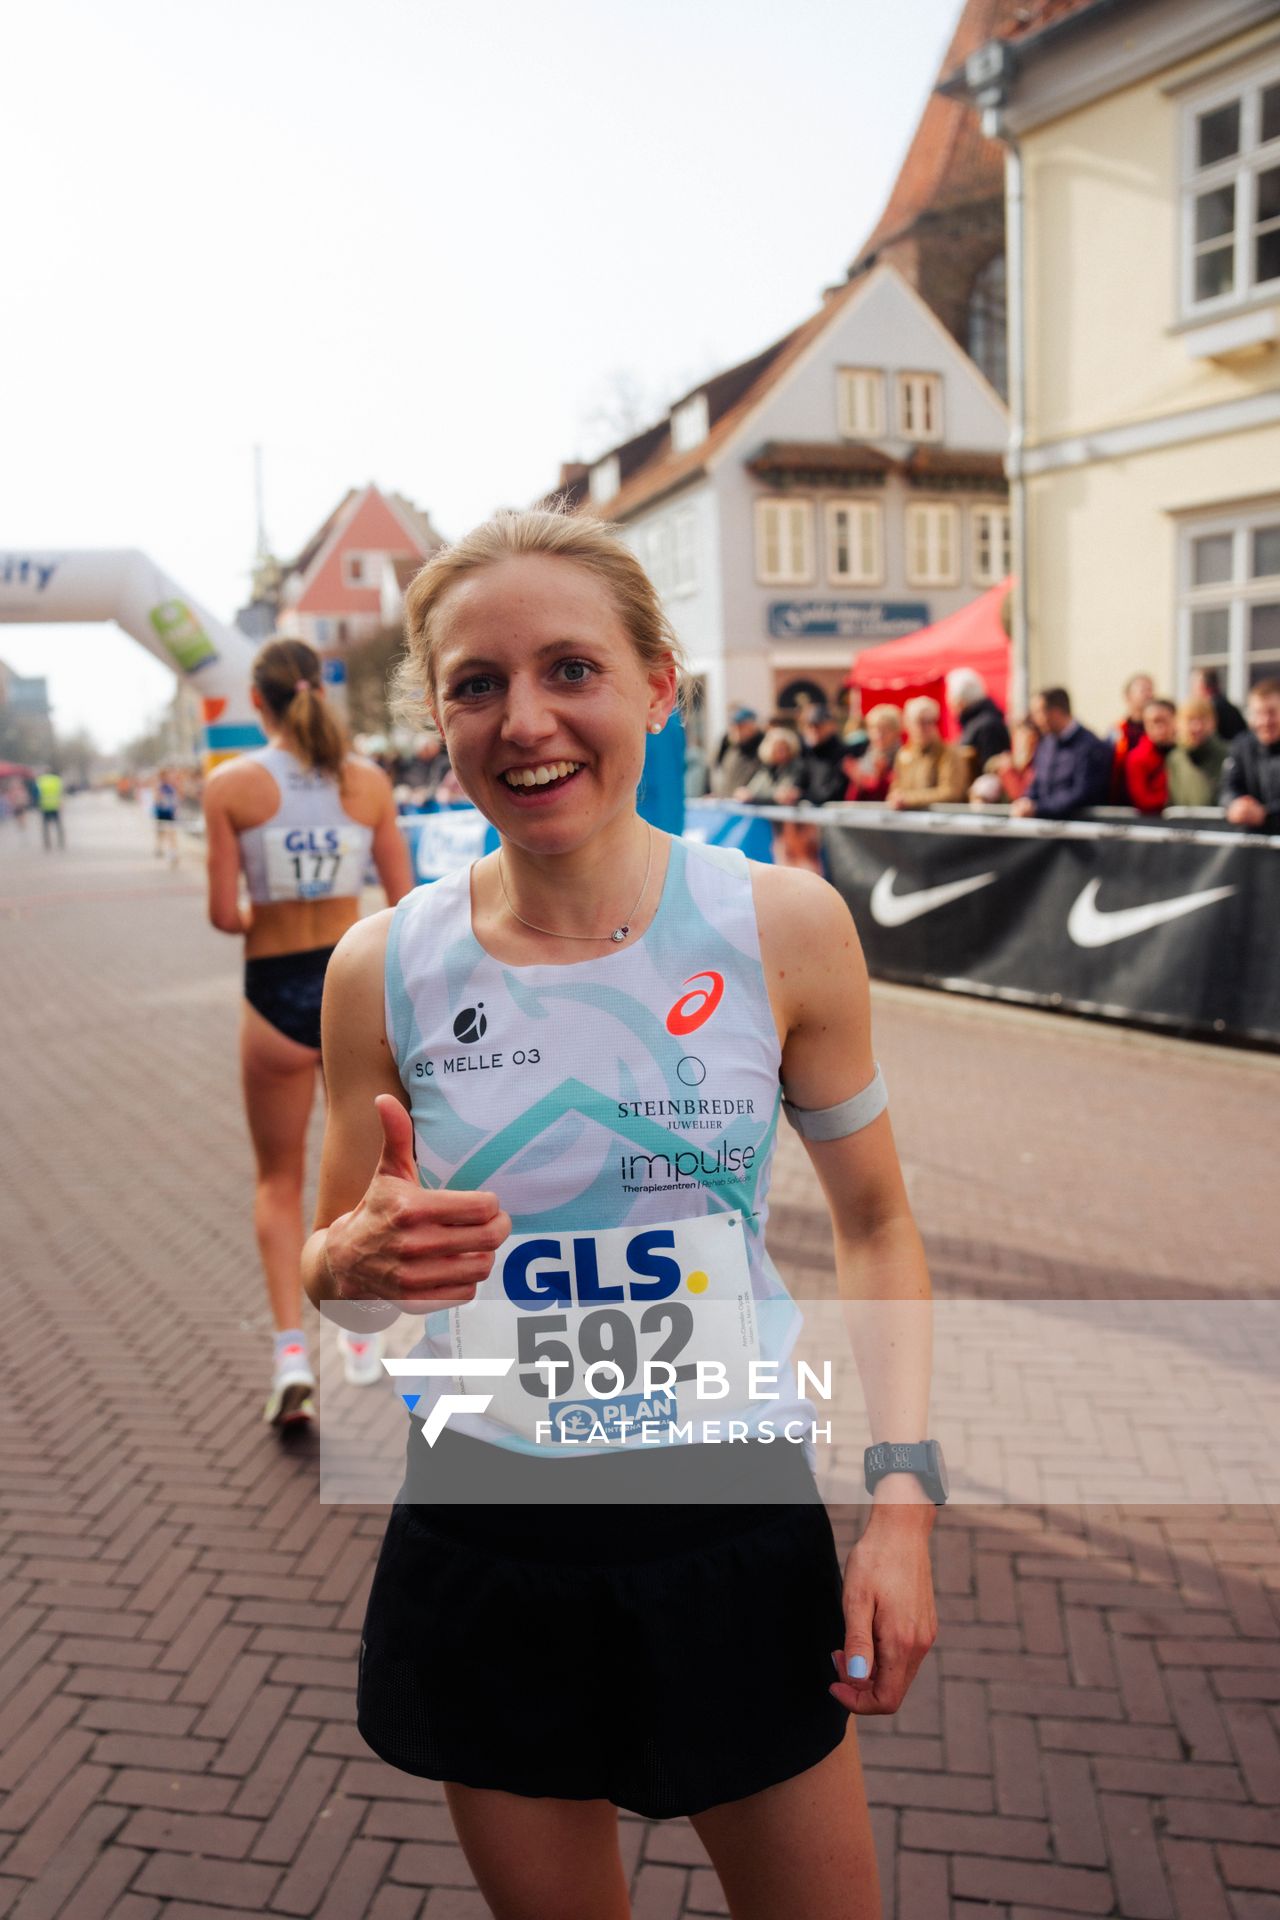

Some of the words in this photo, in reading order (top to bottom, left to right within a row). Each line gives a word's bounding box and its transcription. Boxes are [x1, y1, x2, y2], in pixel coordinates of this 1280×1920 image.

[290, 855, 341, 884] 177
[415, 1060, 435, 1078] SC
[443, 1053, 504, 1075] MELLE
[617, 1098, 756, 1119] STEINBREDER
[666, 1119, 723, 1130] JUWELIER
[621, 1139, 756, 1182] impulse
[622, 1180, 697, 1194] Therapiezentren
[516, 1301, 698, 1399] 592
[602, 1398, 672, 1424] PLAN
